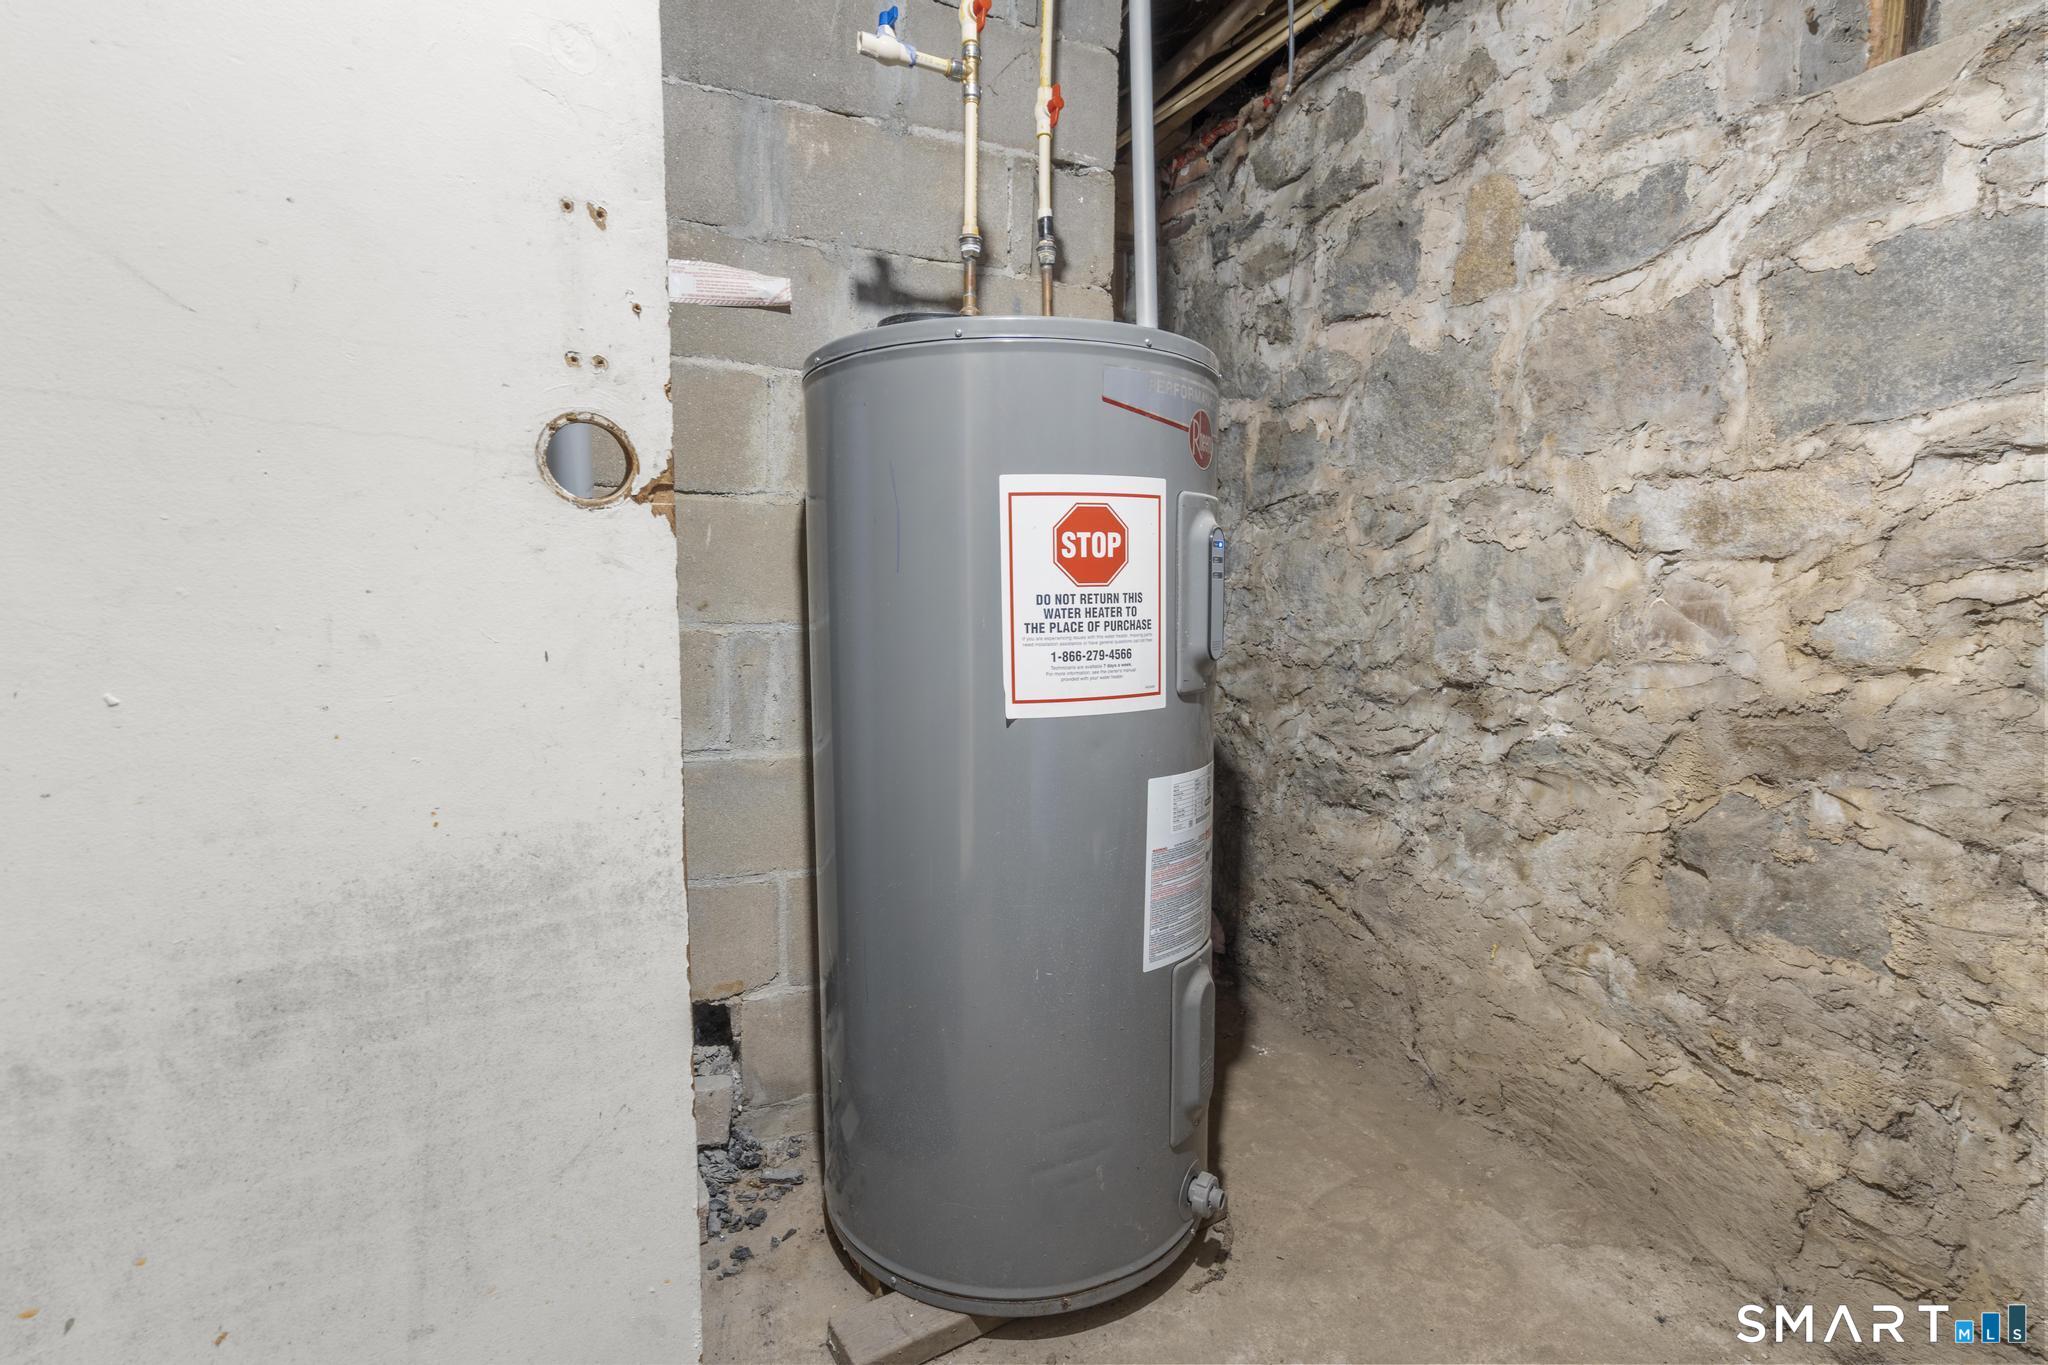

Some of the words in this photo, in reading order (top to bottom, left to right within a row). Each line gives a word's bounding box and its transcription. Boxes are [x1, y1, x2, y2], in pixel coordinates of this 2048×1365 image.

[1061, 531, 1122, 559] STOP
[1036, 594, 1051, 606] DO
[1055, 594, 1076, 605] NOT
[1080, 593, 1120, 604] RETURN
[1122, 592, 1143, 603] THIS
[1044, 608, 1081, 619] WATER
[1084, 606, 1122, 618] HEATER
[1126, 606, 1137, 617] TO
[1024, 622, 1045, 634] THE
[1050, 621, 1084, 633] PLACE
[1088, 621, 1100, 632] OF
[1104, 619, 1152, 631] PURCHASE
[1051, 648, 1132, 663] 1-866-279-4566
